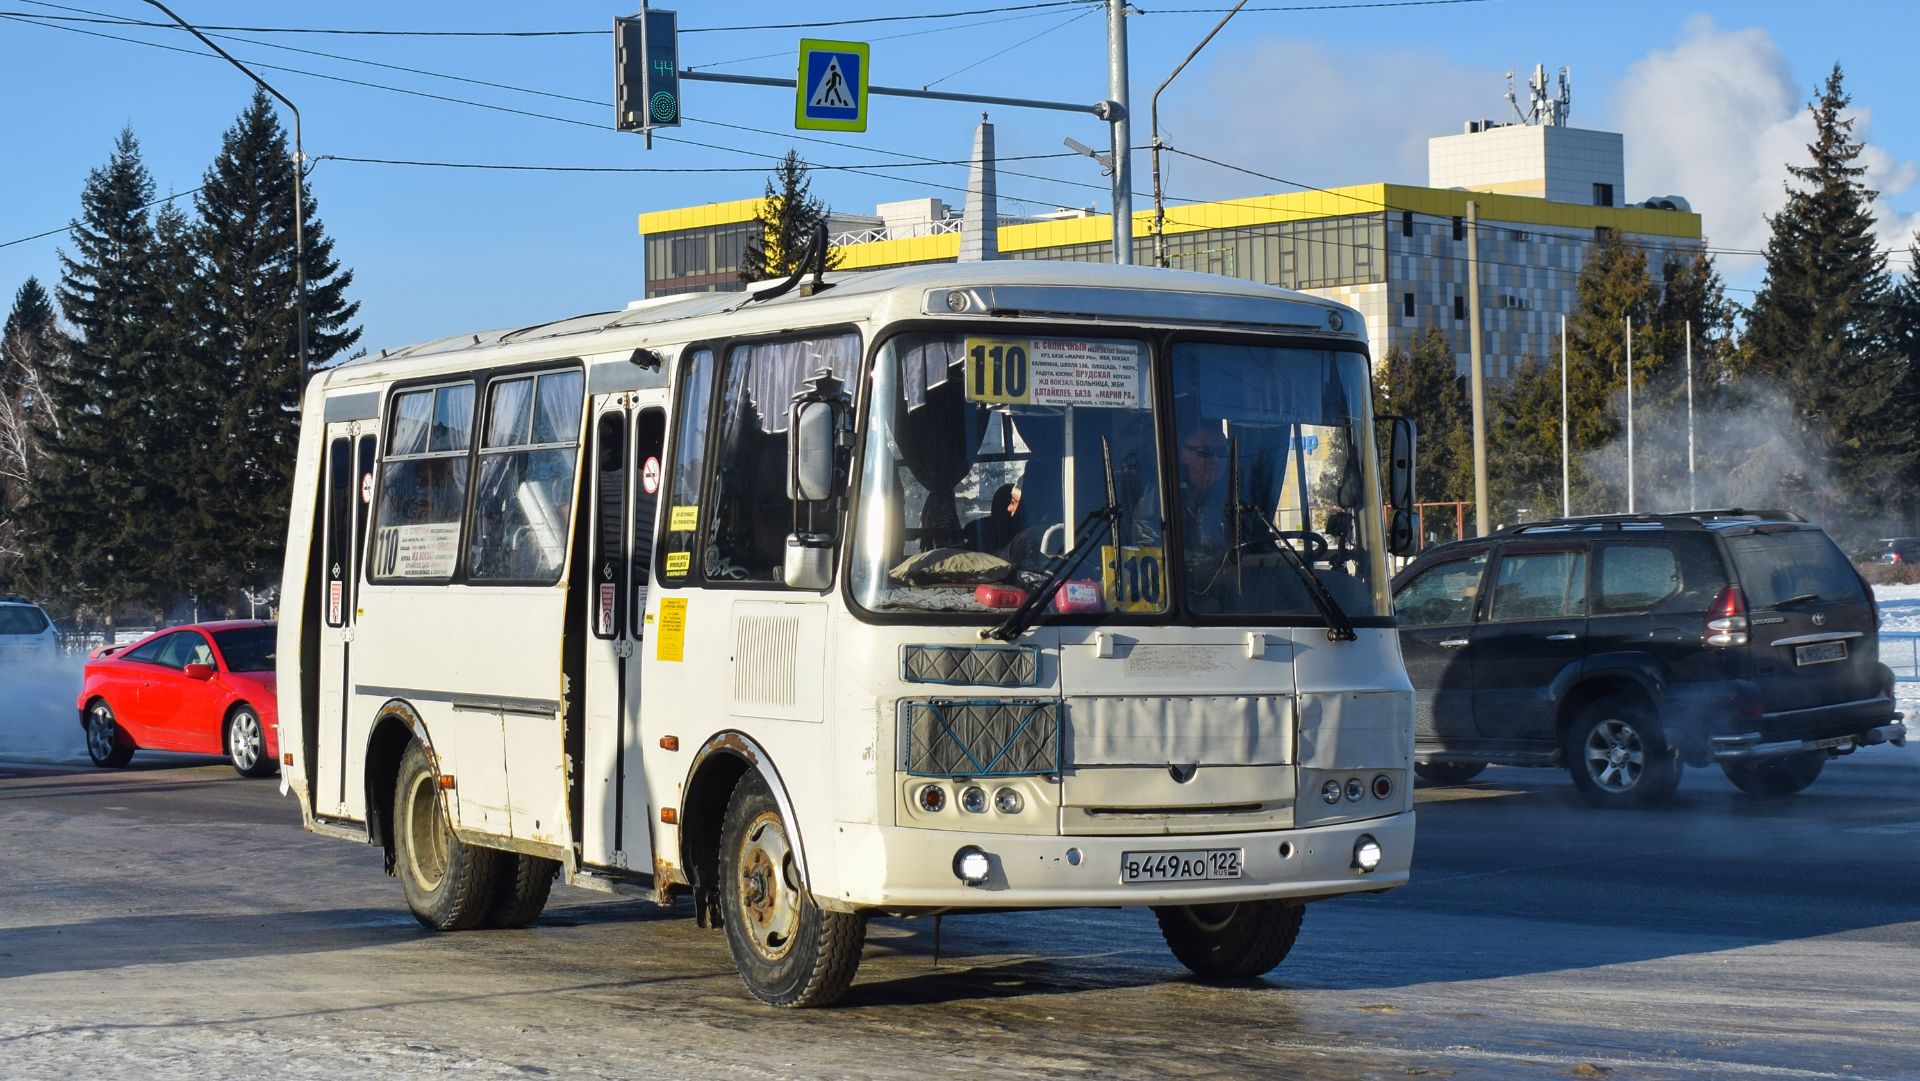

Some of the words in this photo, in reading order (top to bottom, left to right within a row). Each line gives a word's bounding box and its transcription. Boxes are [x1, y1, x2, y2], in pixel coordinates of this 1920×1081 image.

[654, 60, 673, 76] 44
[1043, 342, 1087, 351] СОЛНЕЧНЫЙ
[971, 345, 1027, 398] 110
[1076, 370, 1110, 379] ПРУДСКАЯ
[377, 528, 399, 576] 110
[1128, 855, 1205, 878] В449АО
[1209, 852, 1237, 870] 122
